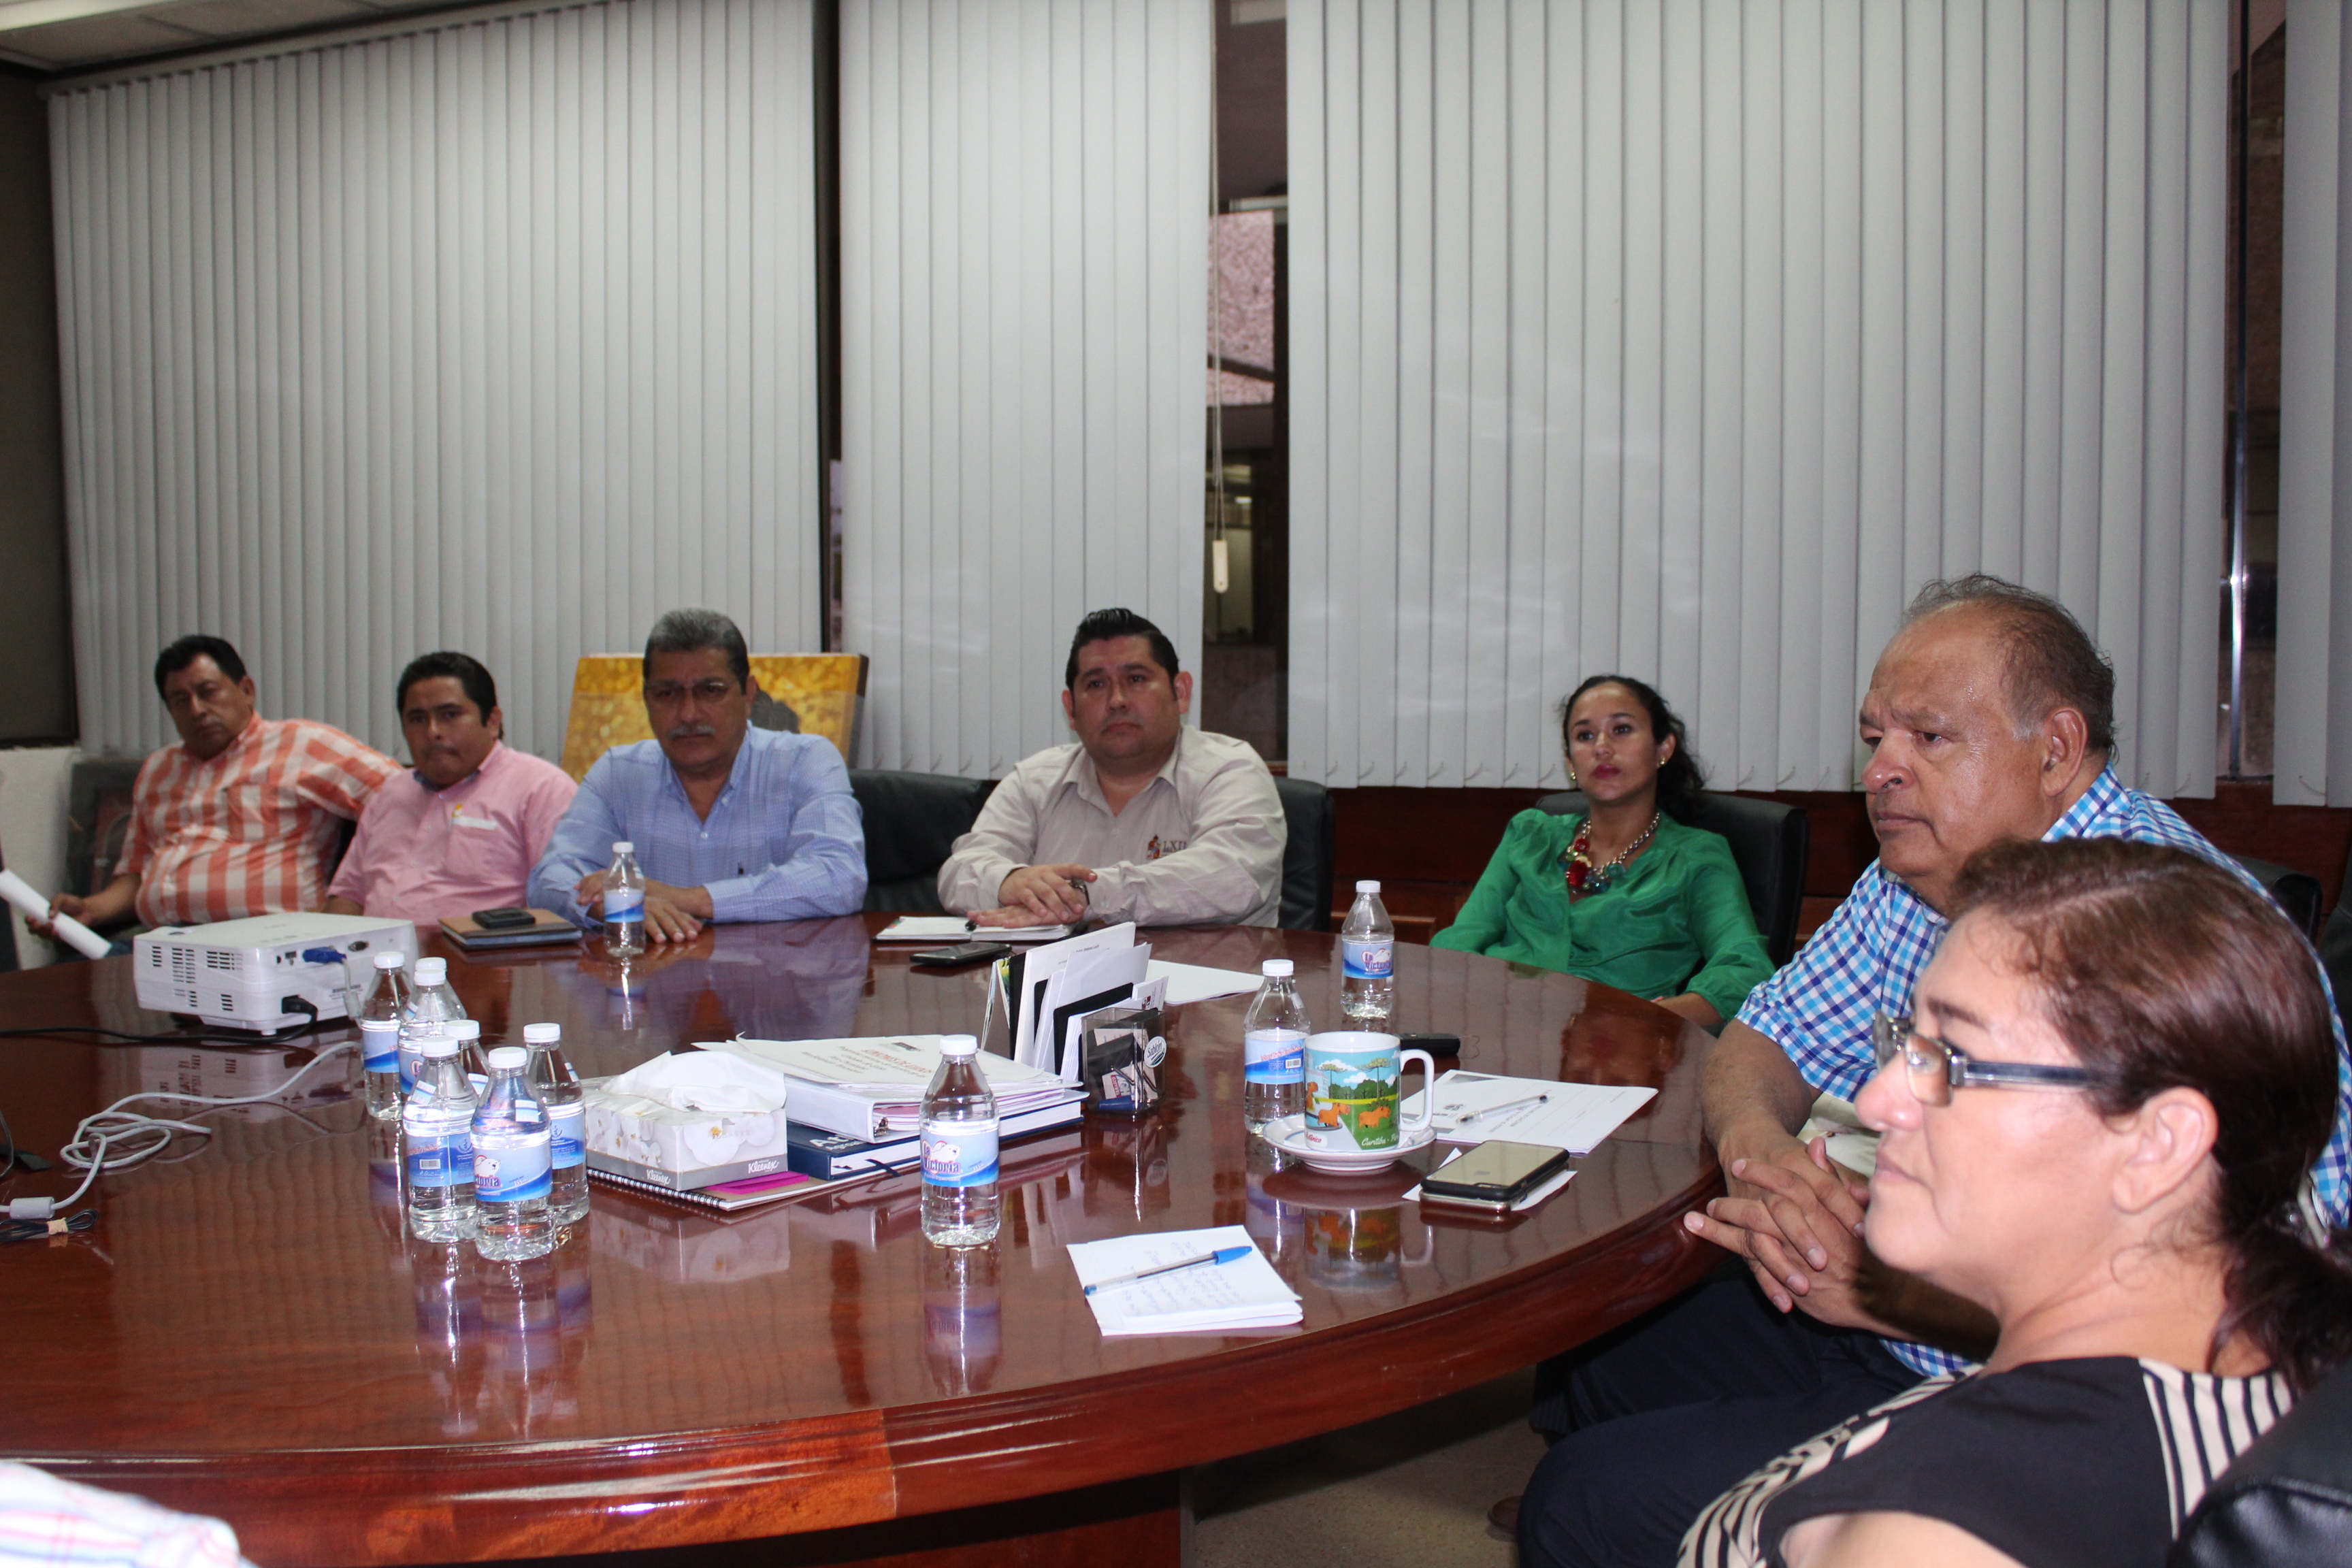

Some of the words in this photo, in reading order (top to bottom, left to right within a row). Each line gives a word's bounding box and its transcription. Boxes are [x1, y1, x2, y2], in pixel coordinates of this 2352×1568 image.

[1365, 953, 1373, 962] La
[1147, 1039, 1162, 1059] Sablón
[1361, 1136, 1386, 1146] Curitiba
[924, 1143, 932, 1157] La
[748, 1160, 779, 1174] Kleenex
[924, 1156, 960, 1174] Victoria
[647, 1169, 671, 1186] Kleenex
